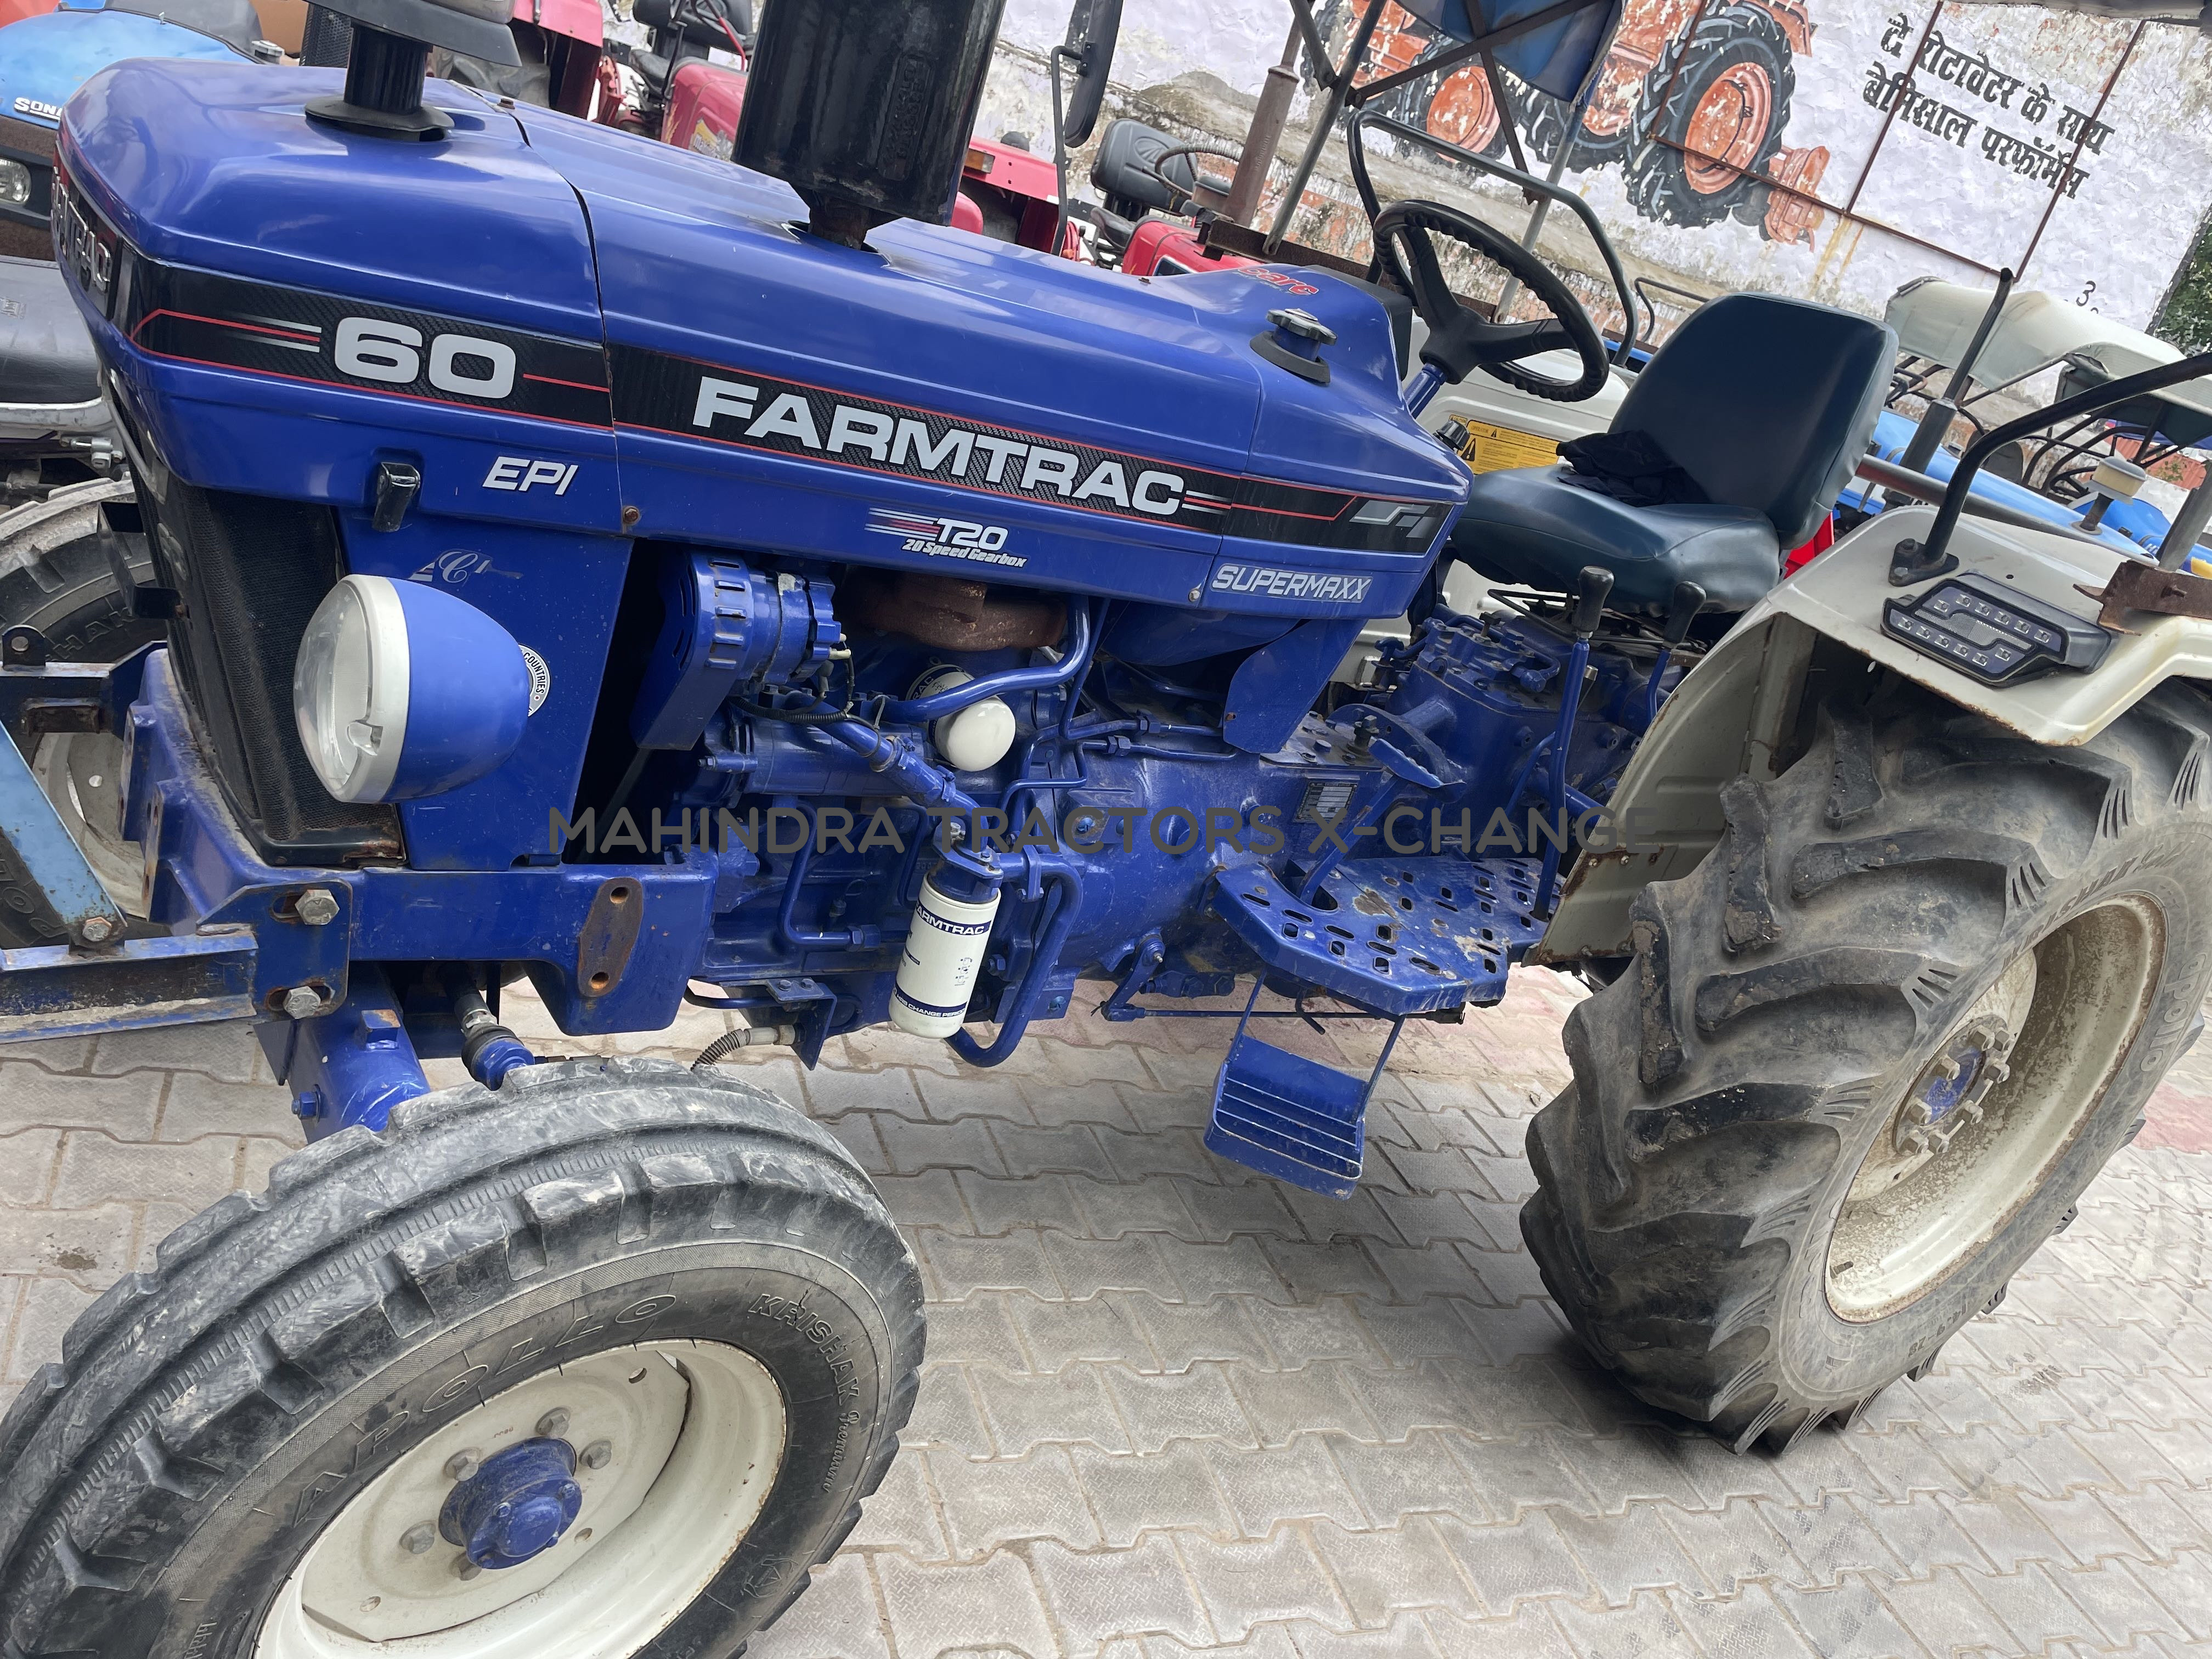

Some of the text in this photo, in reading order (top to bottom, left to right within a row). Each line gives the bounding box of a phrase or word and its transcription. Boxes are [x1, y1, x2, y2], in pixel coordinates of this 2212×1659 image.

[1863, 61, 1978, 148] बेमिसाल
[2021, 82, 2056, 125] के
[2057, 105, 2115, 155] साथ
[335, 317, 516, 398] 60
[482, 456, 578, 495] EPI
[693, 376, 1184, 515] FARMTRAC
[902, 539, 1027, 567] 20 Speed Gearbox
[937, 518, 1008, 551] T20
[1212, 566, 1372, 600] SUPERMAXX
[524, 652, 546, 693] COUNTRIES
[908, 1003, 941, 1017] CHANGE
[2140, 953, 2207, 1071] apollo
[748, 1294, 860, 1406] KRISHAK
[294, 1295, 676, 1527] APOLLO
